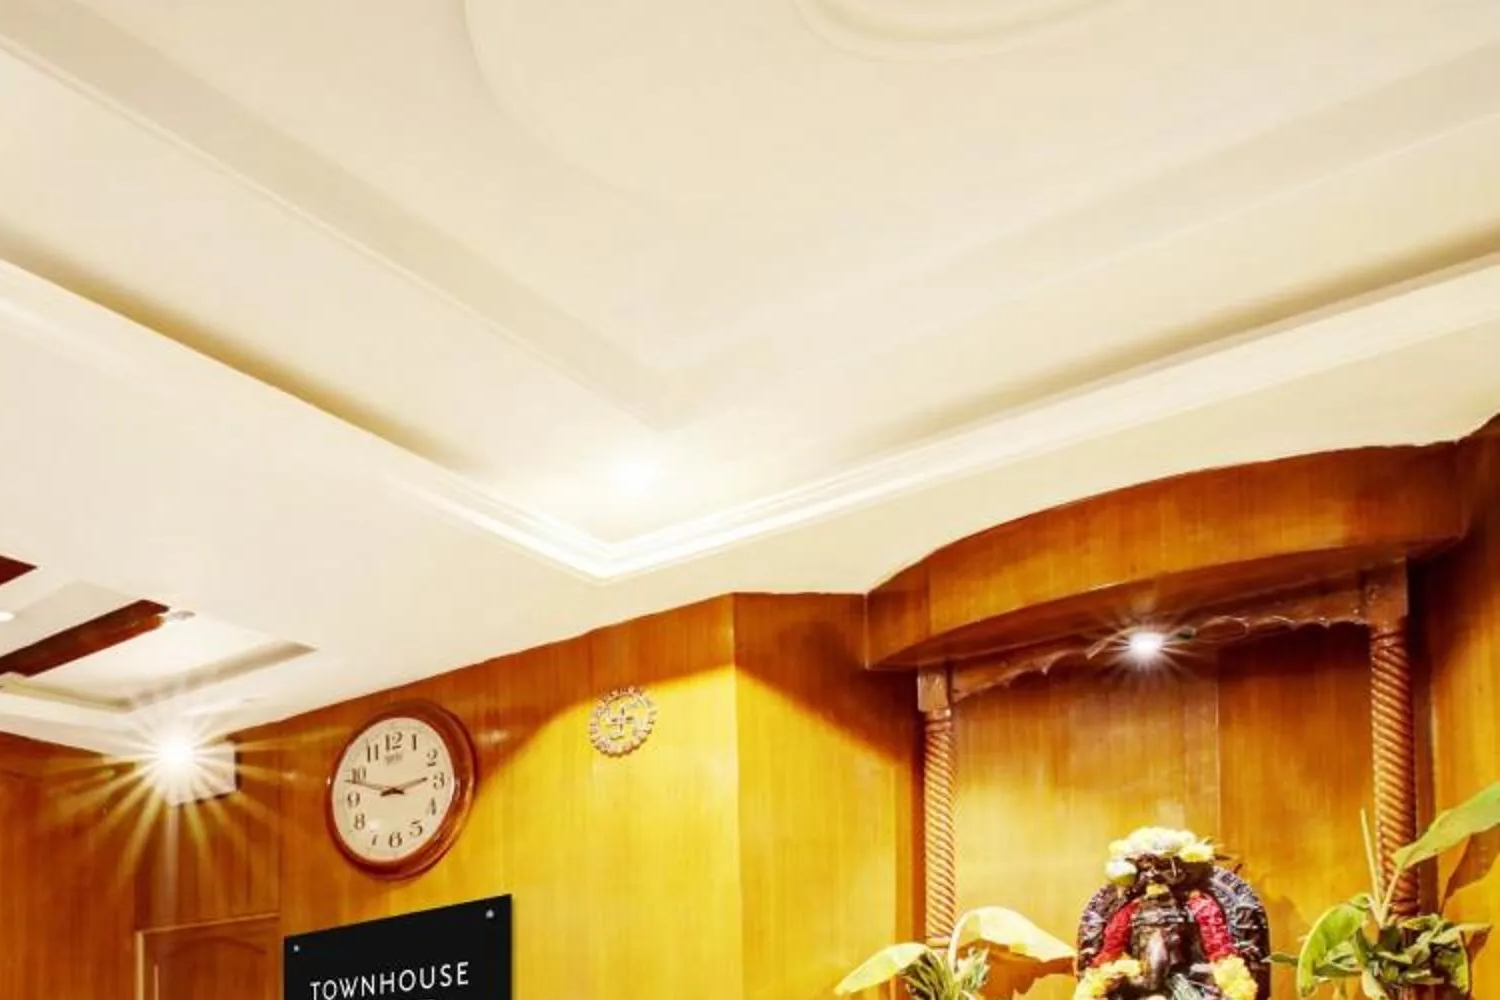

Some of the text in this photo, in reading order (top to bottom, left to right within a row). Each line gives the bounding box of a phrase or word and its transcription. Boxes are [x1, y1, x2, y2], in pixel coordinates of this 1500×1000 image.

[385, 731, 403, 751] 12
[412, 733, 417, 751] 1
[367, 743, 379, 763] 11
[426, 748, 438, 767] 2
[433, 771, 445, 789] 3
[347, 792, 360, 808] 9
[353, 813, 365, 830] 8
[409, 819, 424, 837] 5
[388, 832, 403, 848] 6
